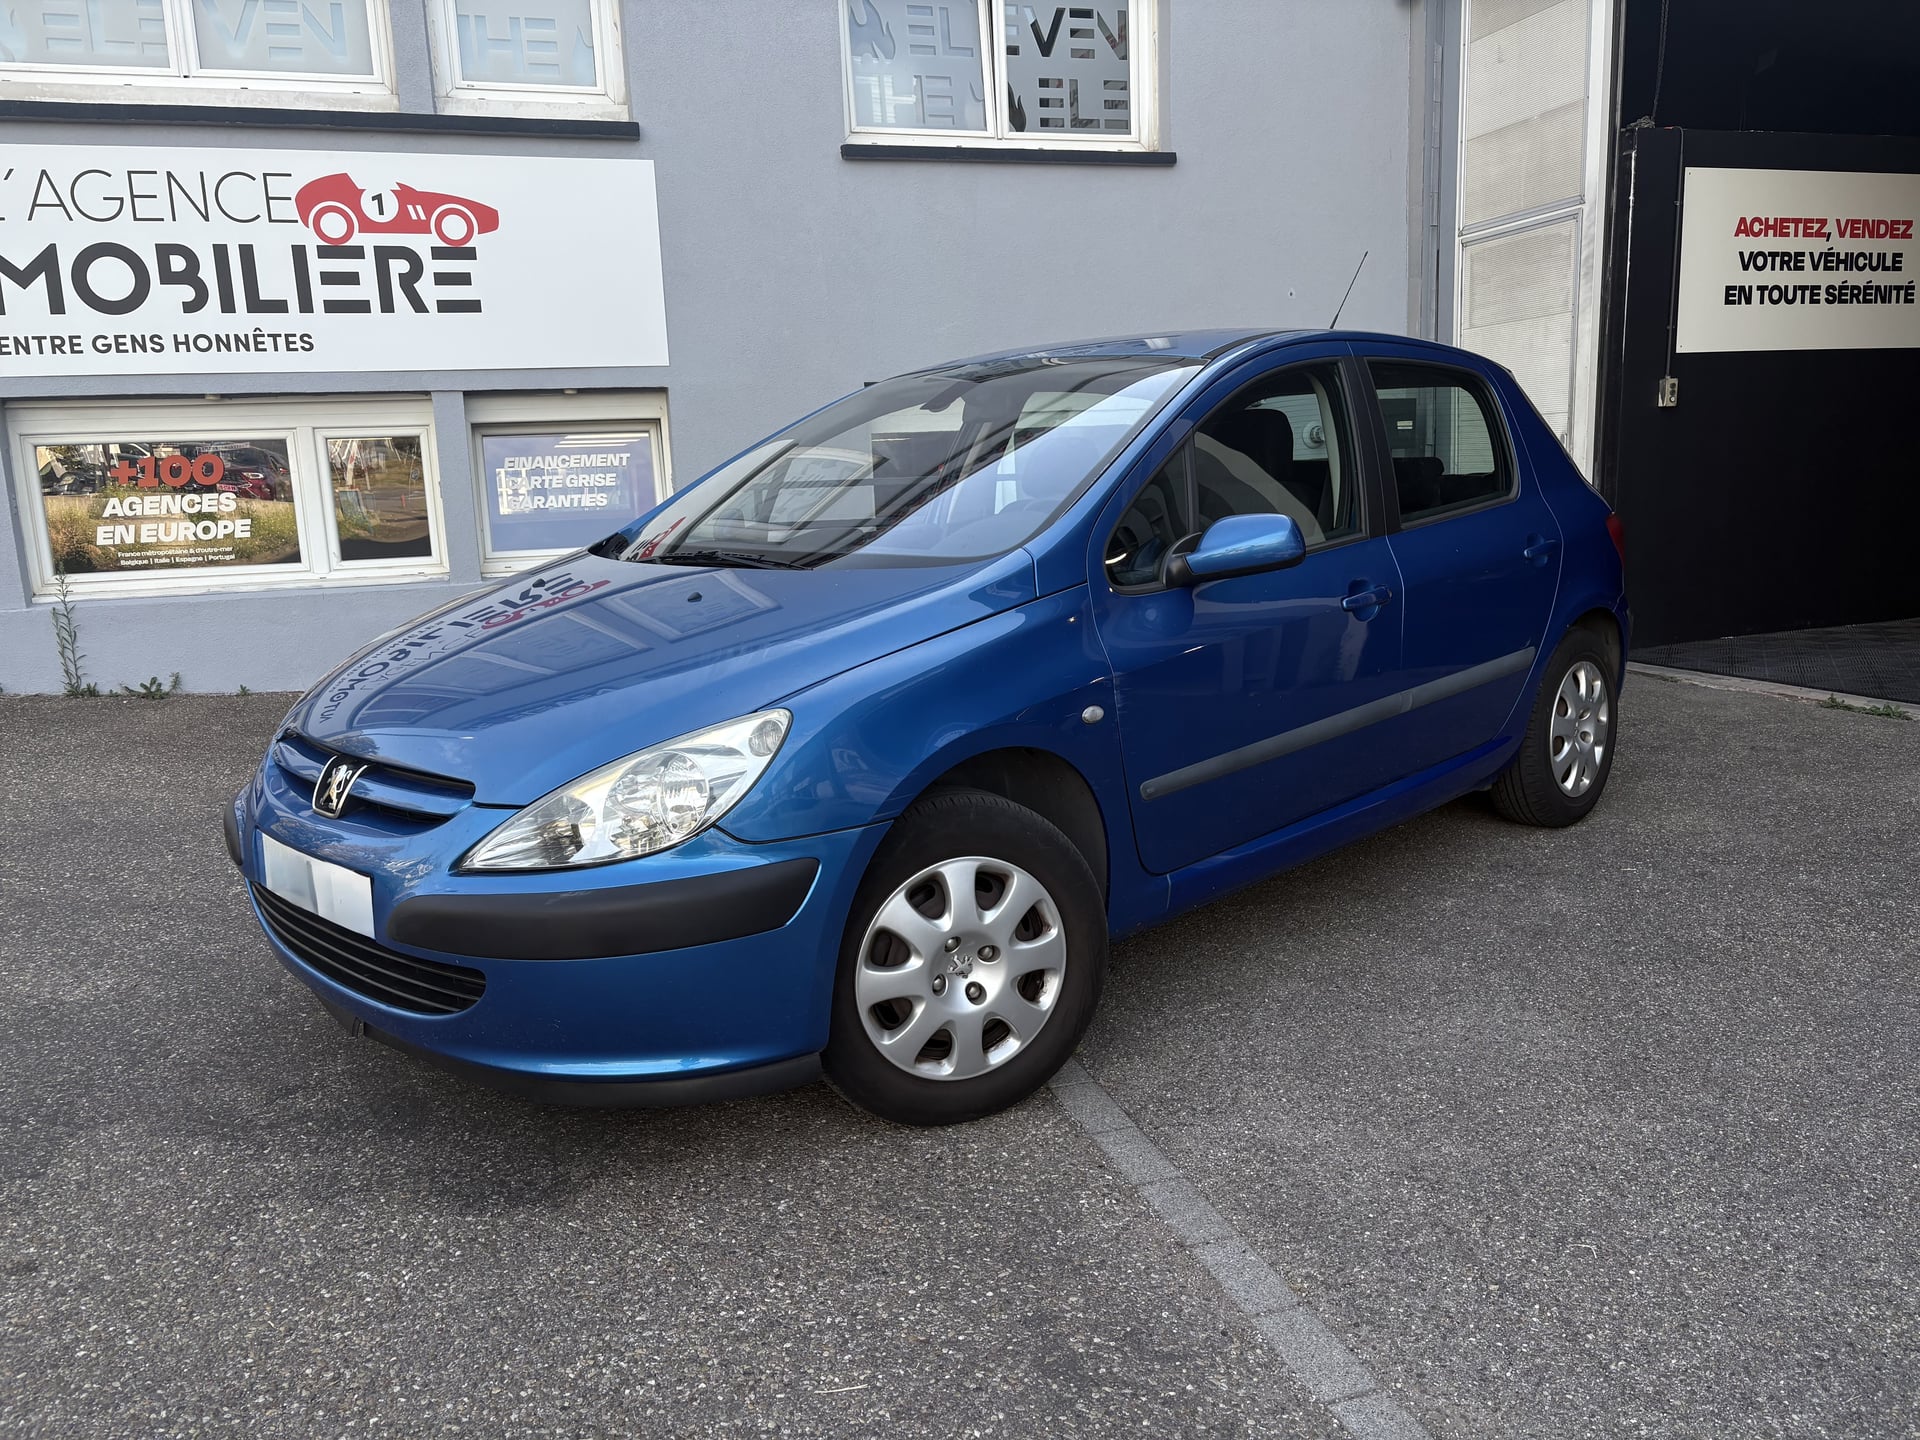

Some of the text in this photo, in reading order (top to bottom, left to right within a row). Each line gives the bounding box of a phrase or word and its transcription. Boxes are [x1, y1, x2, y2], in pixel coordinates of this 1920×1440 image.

[0, 168, 299, 224] 'AGENCE
[1734, 217, 1914, 242] ACHETEZ, VENDEZ
[1738, 247, 1904, 272] VOTRE VÉHICULE
[0, 242, 483, 316] MOBILIERE
[1724, 280, 1916, 306] EN TOUTE SÉRÉNITÉ
[0, 327, 315, 355] ENTRE GENS HONNÊTES
[110, 453, 225, 488] +100
[504, 453, 631, 469] FINANCEMENT
[509, 473, 617, 490] CARTE GRISE
[102, 492, 237, 518] AGENCES
[509, 493, 608, 511] GARANTIES
[96, 519, 251, 546] EN EUROPE
